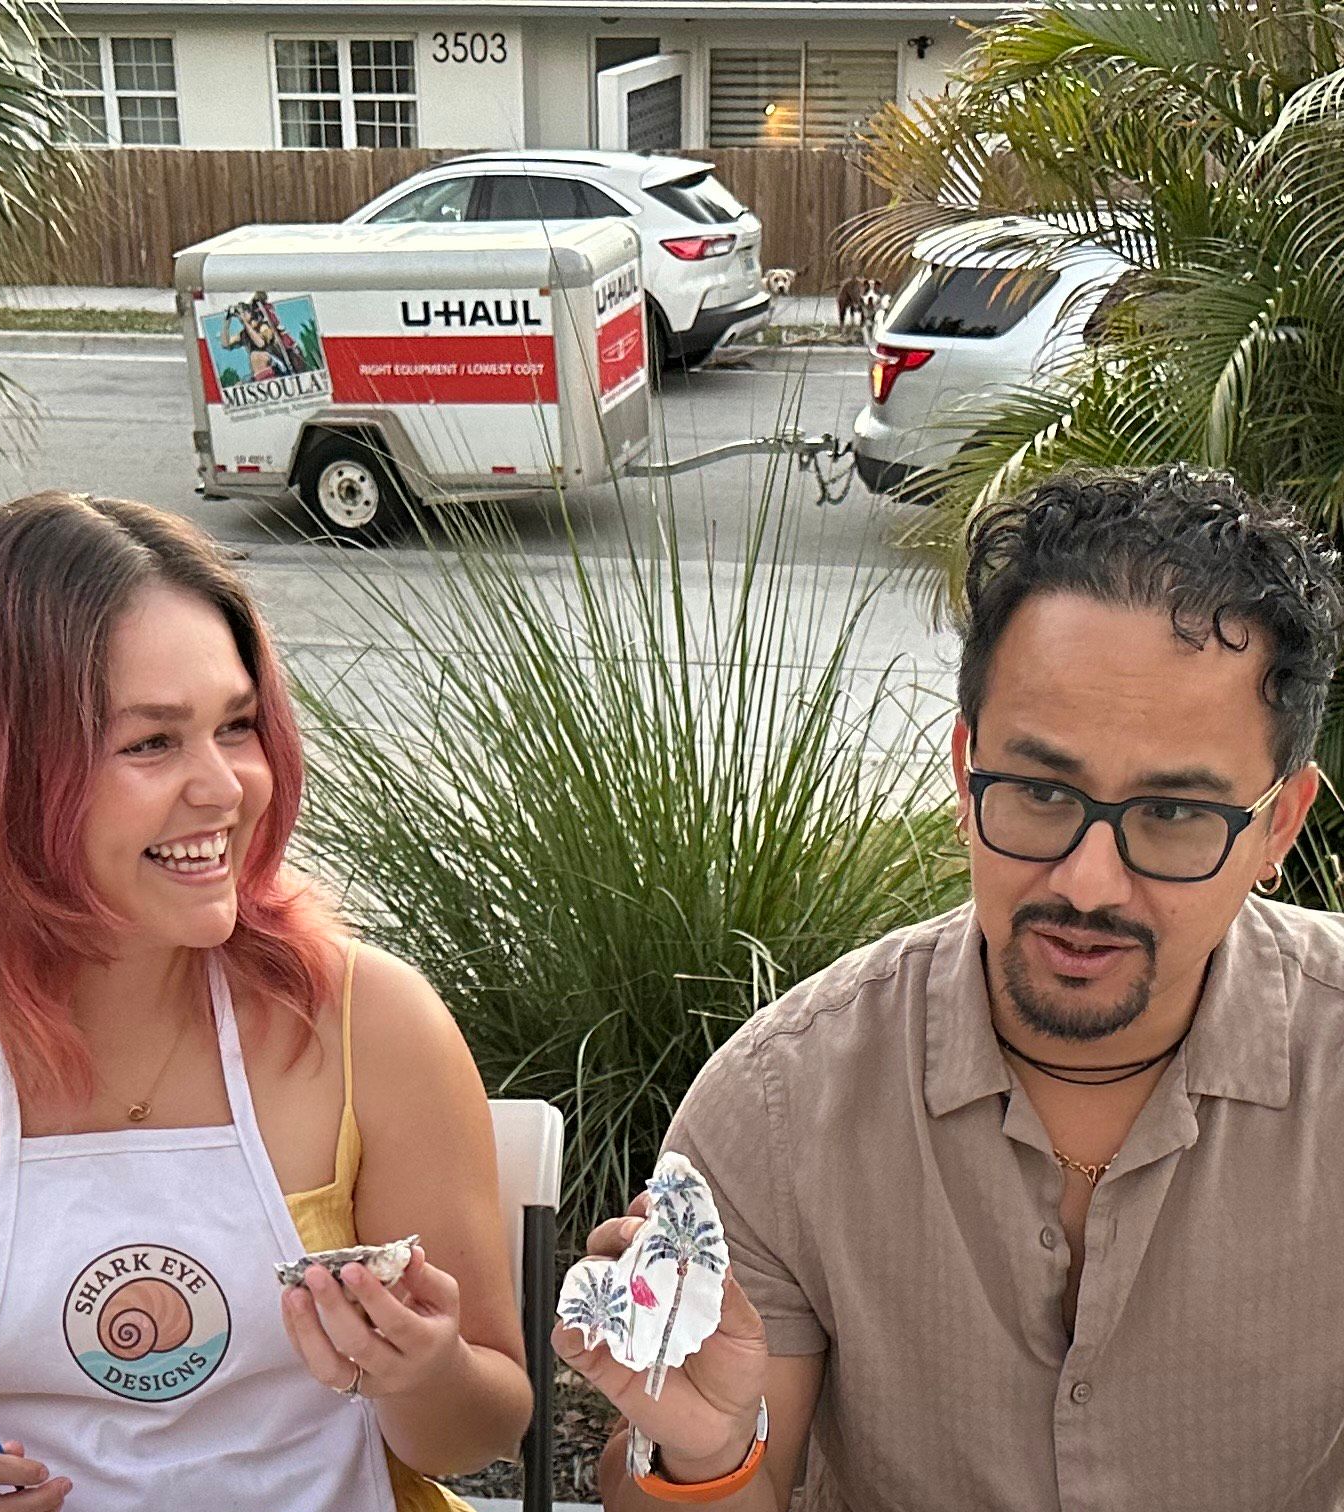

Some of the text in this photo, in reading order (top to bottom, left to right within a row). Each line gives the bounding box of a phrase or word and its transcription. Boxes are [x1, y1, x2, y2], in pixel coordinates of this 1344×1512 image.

[432, 32, 507, 63] 3503
[595, 268, 638, 316] U-HAUL
[401, 300, 541, 327] U-HAUL
[359, 364, 392, 376] RIGHT
[393, 364, 456, 376] EQUIPMENT
[467, 364, 511, 376] LOWEST
[513, 364, 544, 376] COST
[222, 374, 322, 407] MISSOULA
[75, 1253, 206, 1315] SHARK EYE
[103, 1352, 207, 1391] DESIGNS
